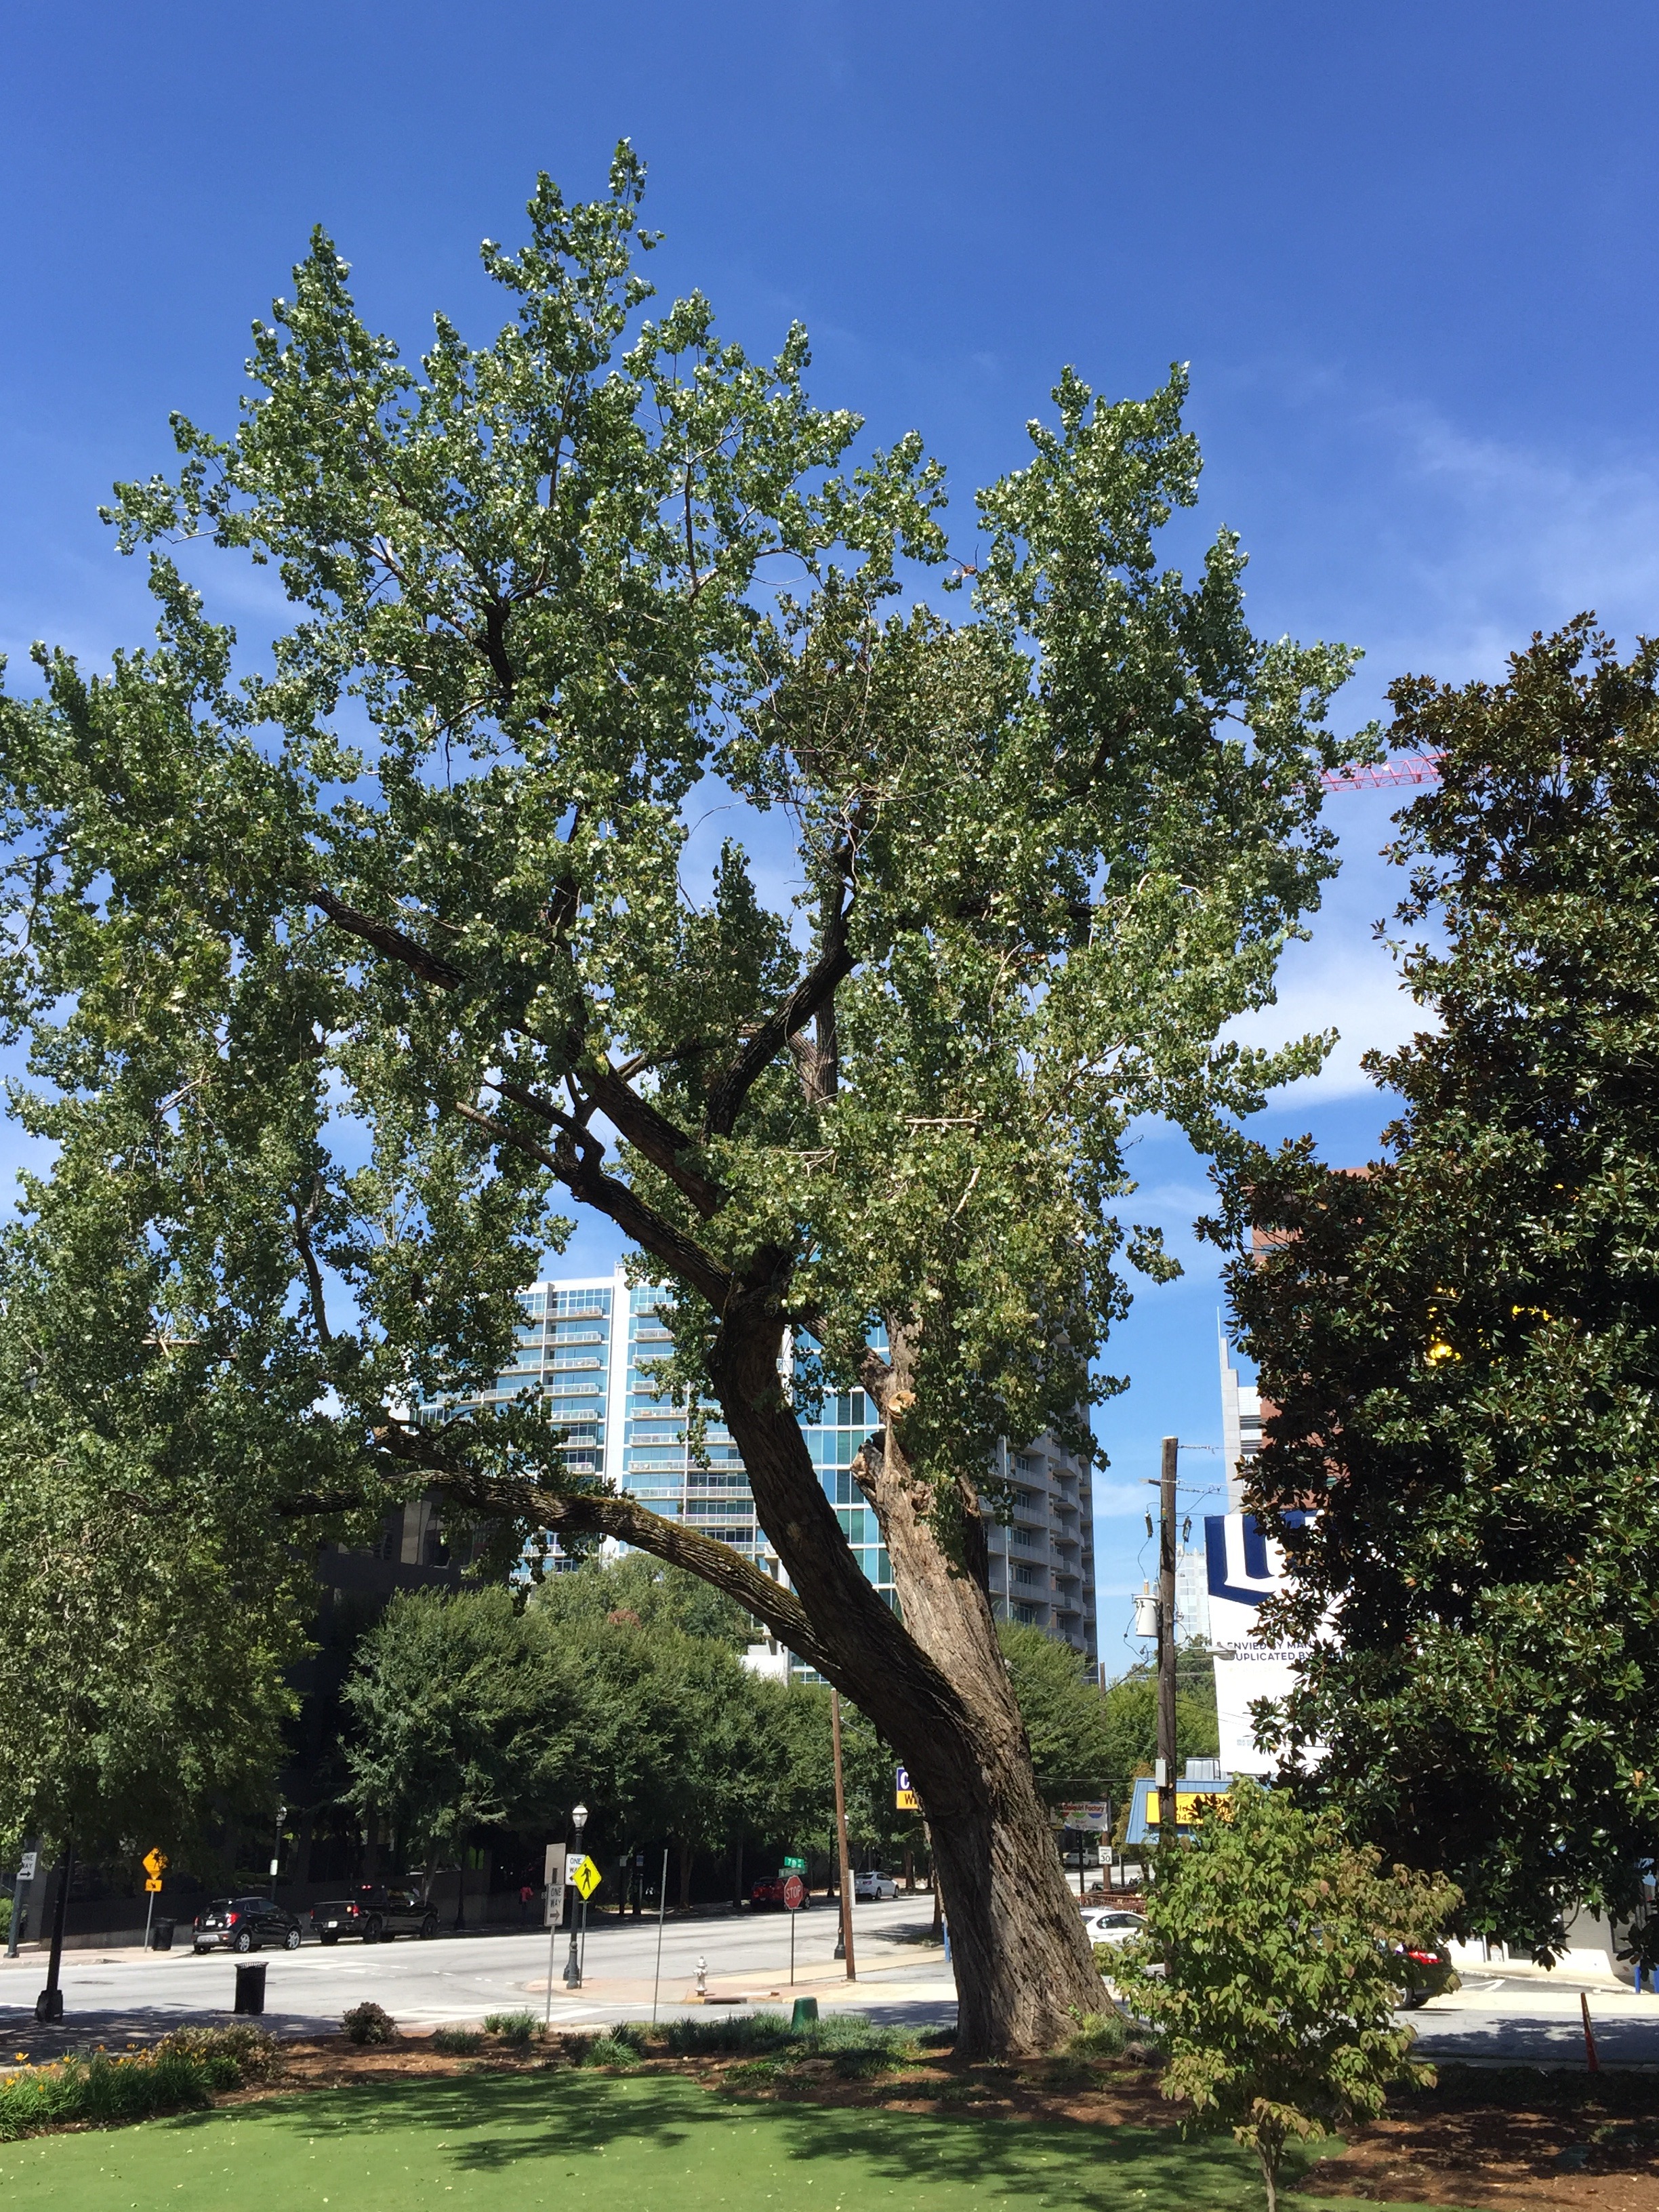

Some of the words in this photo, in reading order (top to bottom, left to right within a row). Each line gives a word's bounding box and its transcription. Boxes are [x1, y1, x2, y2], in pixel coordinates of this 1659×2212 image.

[1234, 1652, 1295, 1661] UPLICATED
[1084, 1804, 1105, 1813] Factory
[1101, 1855, 1111, 1863] 30
[551, 1887, 562, 1897] ONE
[785, 1885, 801, 1900] STOP
[550, 1899, 561, 1908] WAY
